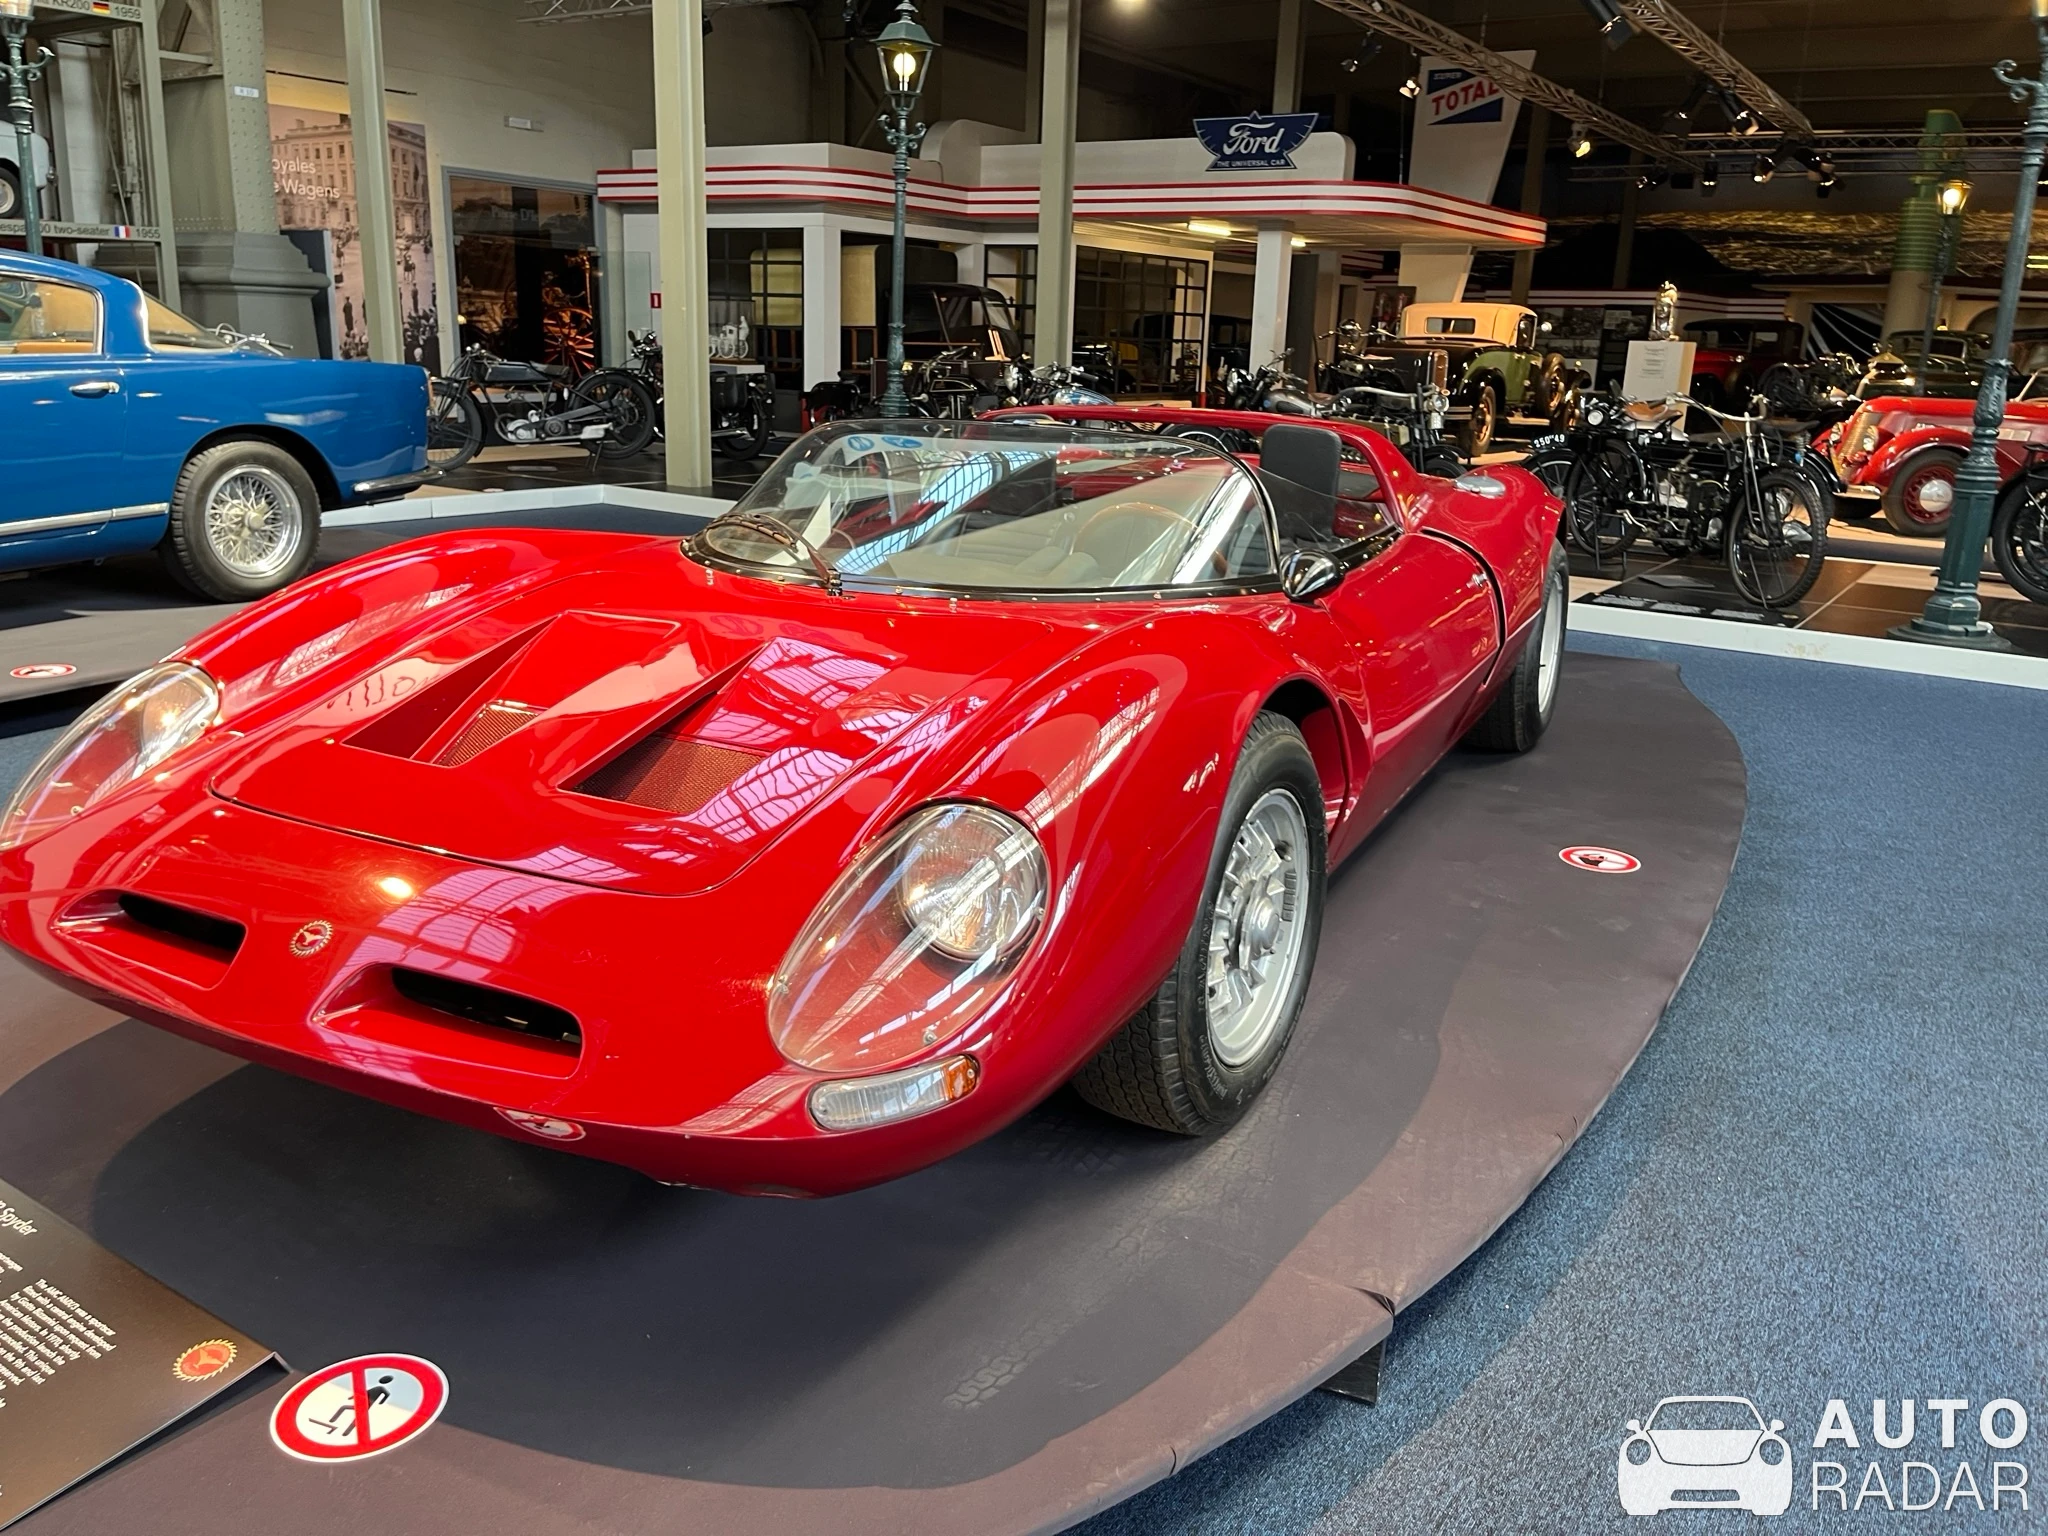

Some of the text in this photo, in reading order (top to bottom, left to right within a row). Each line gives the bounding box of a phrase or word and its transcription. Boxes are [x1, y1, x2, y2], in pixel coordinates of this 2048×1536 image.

[114, 7, 142, 19] 1959
[1431, 80, 1500, 116] TOTAL
[1222, 122, 1285, 155] Ford
[271, 156, 316, 175] oyales
[1217, 160, 1229, 168] THE
[1231, 160, 1269, 168] UNIVERSAL
[282, 178, 341, 200] Wagens
[0, 223, 26, 234] espa
[54, 224, 111, 236] two-seater
[136, 228, 161, 239] 1955
[0, 1207, 38, 1236] Spyder
[35, 1279, 48, 1289] The
[8, 1324, 40, 1347] production
[53, 1323, 71, 1337] upon
[85, 1345, 102, 1359] from
[66, 1317, 87, 1332] engine
[83, 1329, 117, 1352] developed
